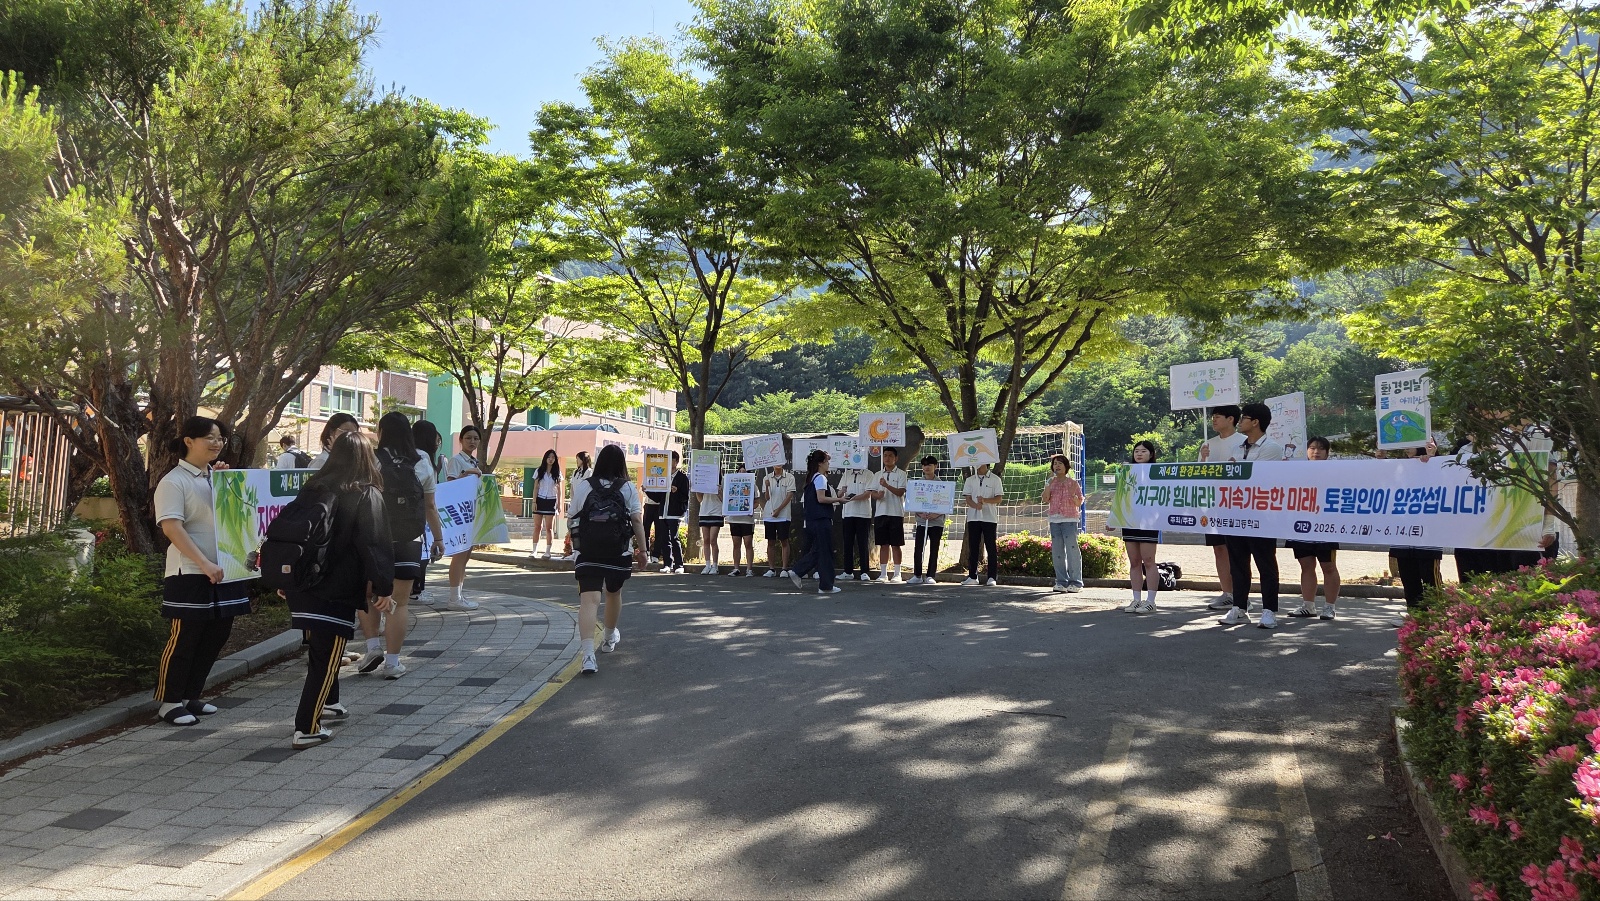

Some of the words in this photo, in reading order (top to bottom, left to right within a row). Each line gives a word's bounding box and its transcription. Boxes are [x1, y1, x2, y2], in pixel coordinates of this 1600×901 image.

[1158, 465, 1178, 477] 제4회
[1179, 464, 1224, 478] 환경교육주간
[1225, 464, 1243, 477] 맞이
[280, 472, 300, 492] 제4회
[1135, 485, 1171, 507] 지구야
[1172, 485, 1216, 509] 힘내라!
[1218, 486, 1286, 511] 지속가능한
[1286, 486, 1320, 514] 미래,
[1323, 487, 1391, 515] 토월인이
[1391, 484, 1487, 515] 앞장섭니다!
[1209, 516, 1260, 530] 창원토월고등학교
[1296, 522, 1310, 532] 기간
[1313, 523, 1338, 534] 2025.
[1340, 524, 1348, 534] 6.
[1350, 524, 1373, 536] 2.(월)
[1384, 525, 1392, 536] 6.
[1395, 525, 1424, 537] 14.(토)
